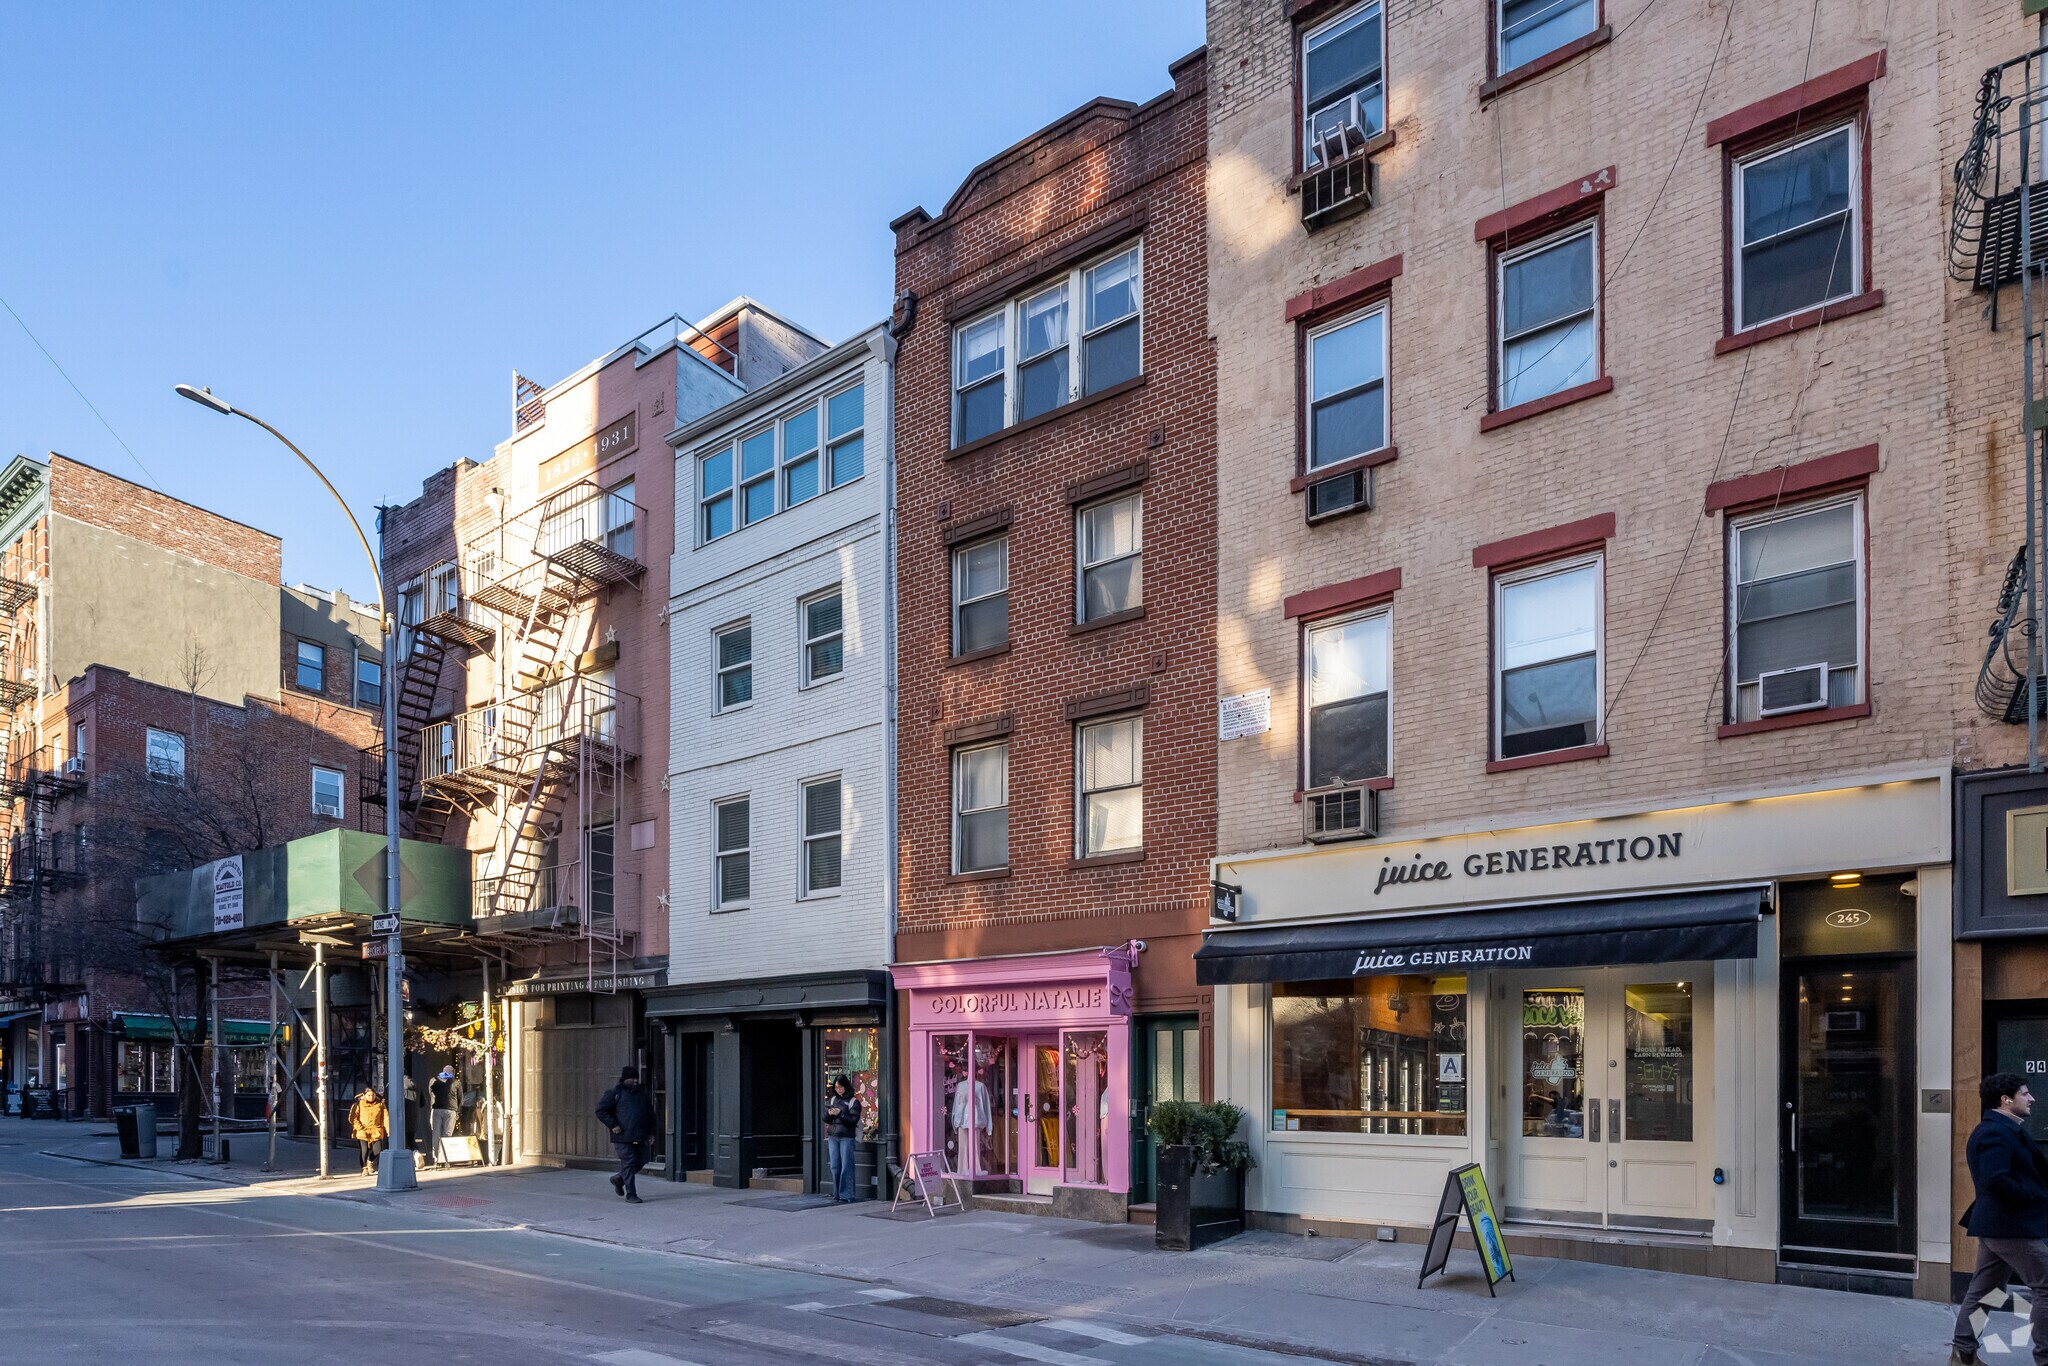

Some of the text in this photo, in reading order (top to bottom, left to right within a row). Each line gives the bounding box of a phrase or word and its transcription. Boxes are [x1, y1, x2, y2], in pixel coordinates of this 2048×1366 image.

[593, 425, 629, 457] 1931
[1373, 832, 1683, 895] juice GENERATION
[375, 919, 397, 929] ONE WAY
[1837, 913, 1860, 924] 245
[1352, 946, 1533, 975] juice GENERATION
[502, 983, 529, 995] DESIGN
[531, 982, 545, 993] FOR
[547, 981, 585, 992] PRINTING
[931, 988, 1102, 1014] COLORFUL NATALIE
[1443, 1057, 1458, 1074] A
[2026, 1061, 2046, 1072] 24
[1466, 1187, 1480, 1203] YOUR
